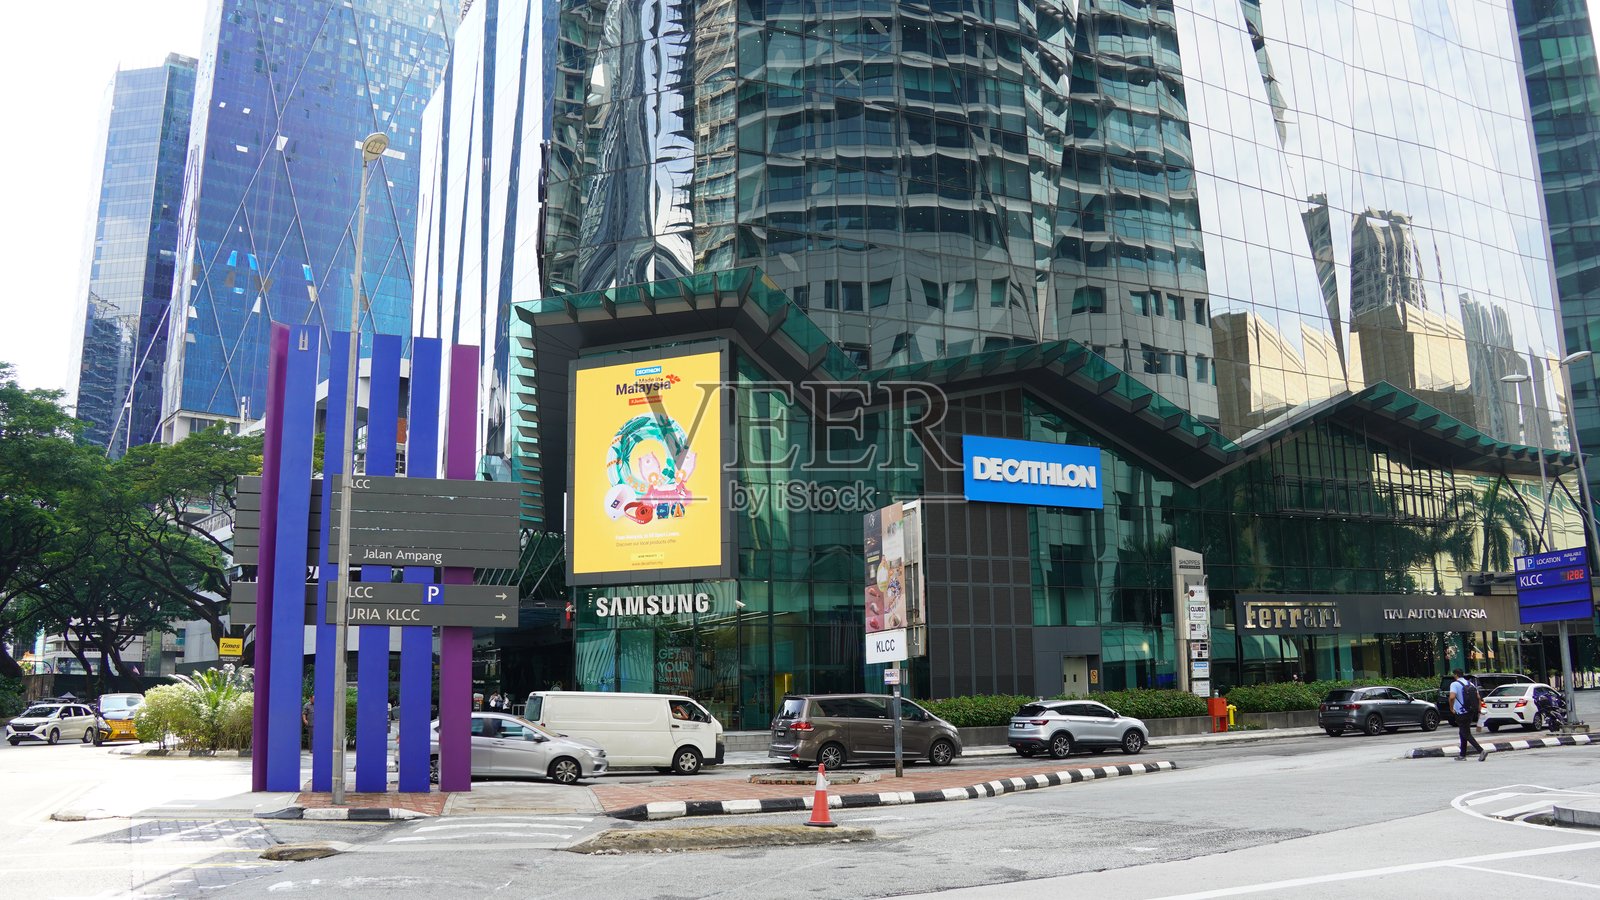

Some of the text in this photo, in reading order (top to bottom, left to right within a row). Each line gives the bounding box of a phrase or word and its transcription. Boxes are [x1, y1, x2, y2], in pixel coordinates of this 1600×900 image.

[616, 379, 671, 396] Malaysia
[972, 456, 1097, 489] DECATHLON
[351, 479, 371, 489] LCC
[363, 549, 442, 565] Jalan Ampang
[1528, 557, 1561, 568] P LOCATION
[1520, 573, 1544, 587] KLCC
[1567, 569, 1584, 581] 1282
[349, 585, 440, 602] LCC P
[596, 592, 709, 617] SAMSUNG
[349, 608, 420, 621] URIA KLCC
[1243, 601, 1341, 629] Ferrari
[1407, 608, 1436, 620] AUTO
[1437, 608, 1488, 620] MALAYSIA
[876, 638, 895, 653] KLCC
[658, 648, 681, 659] GET
[658, 661, 689, 673] YOUR
